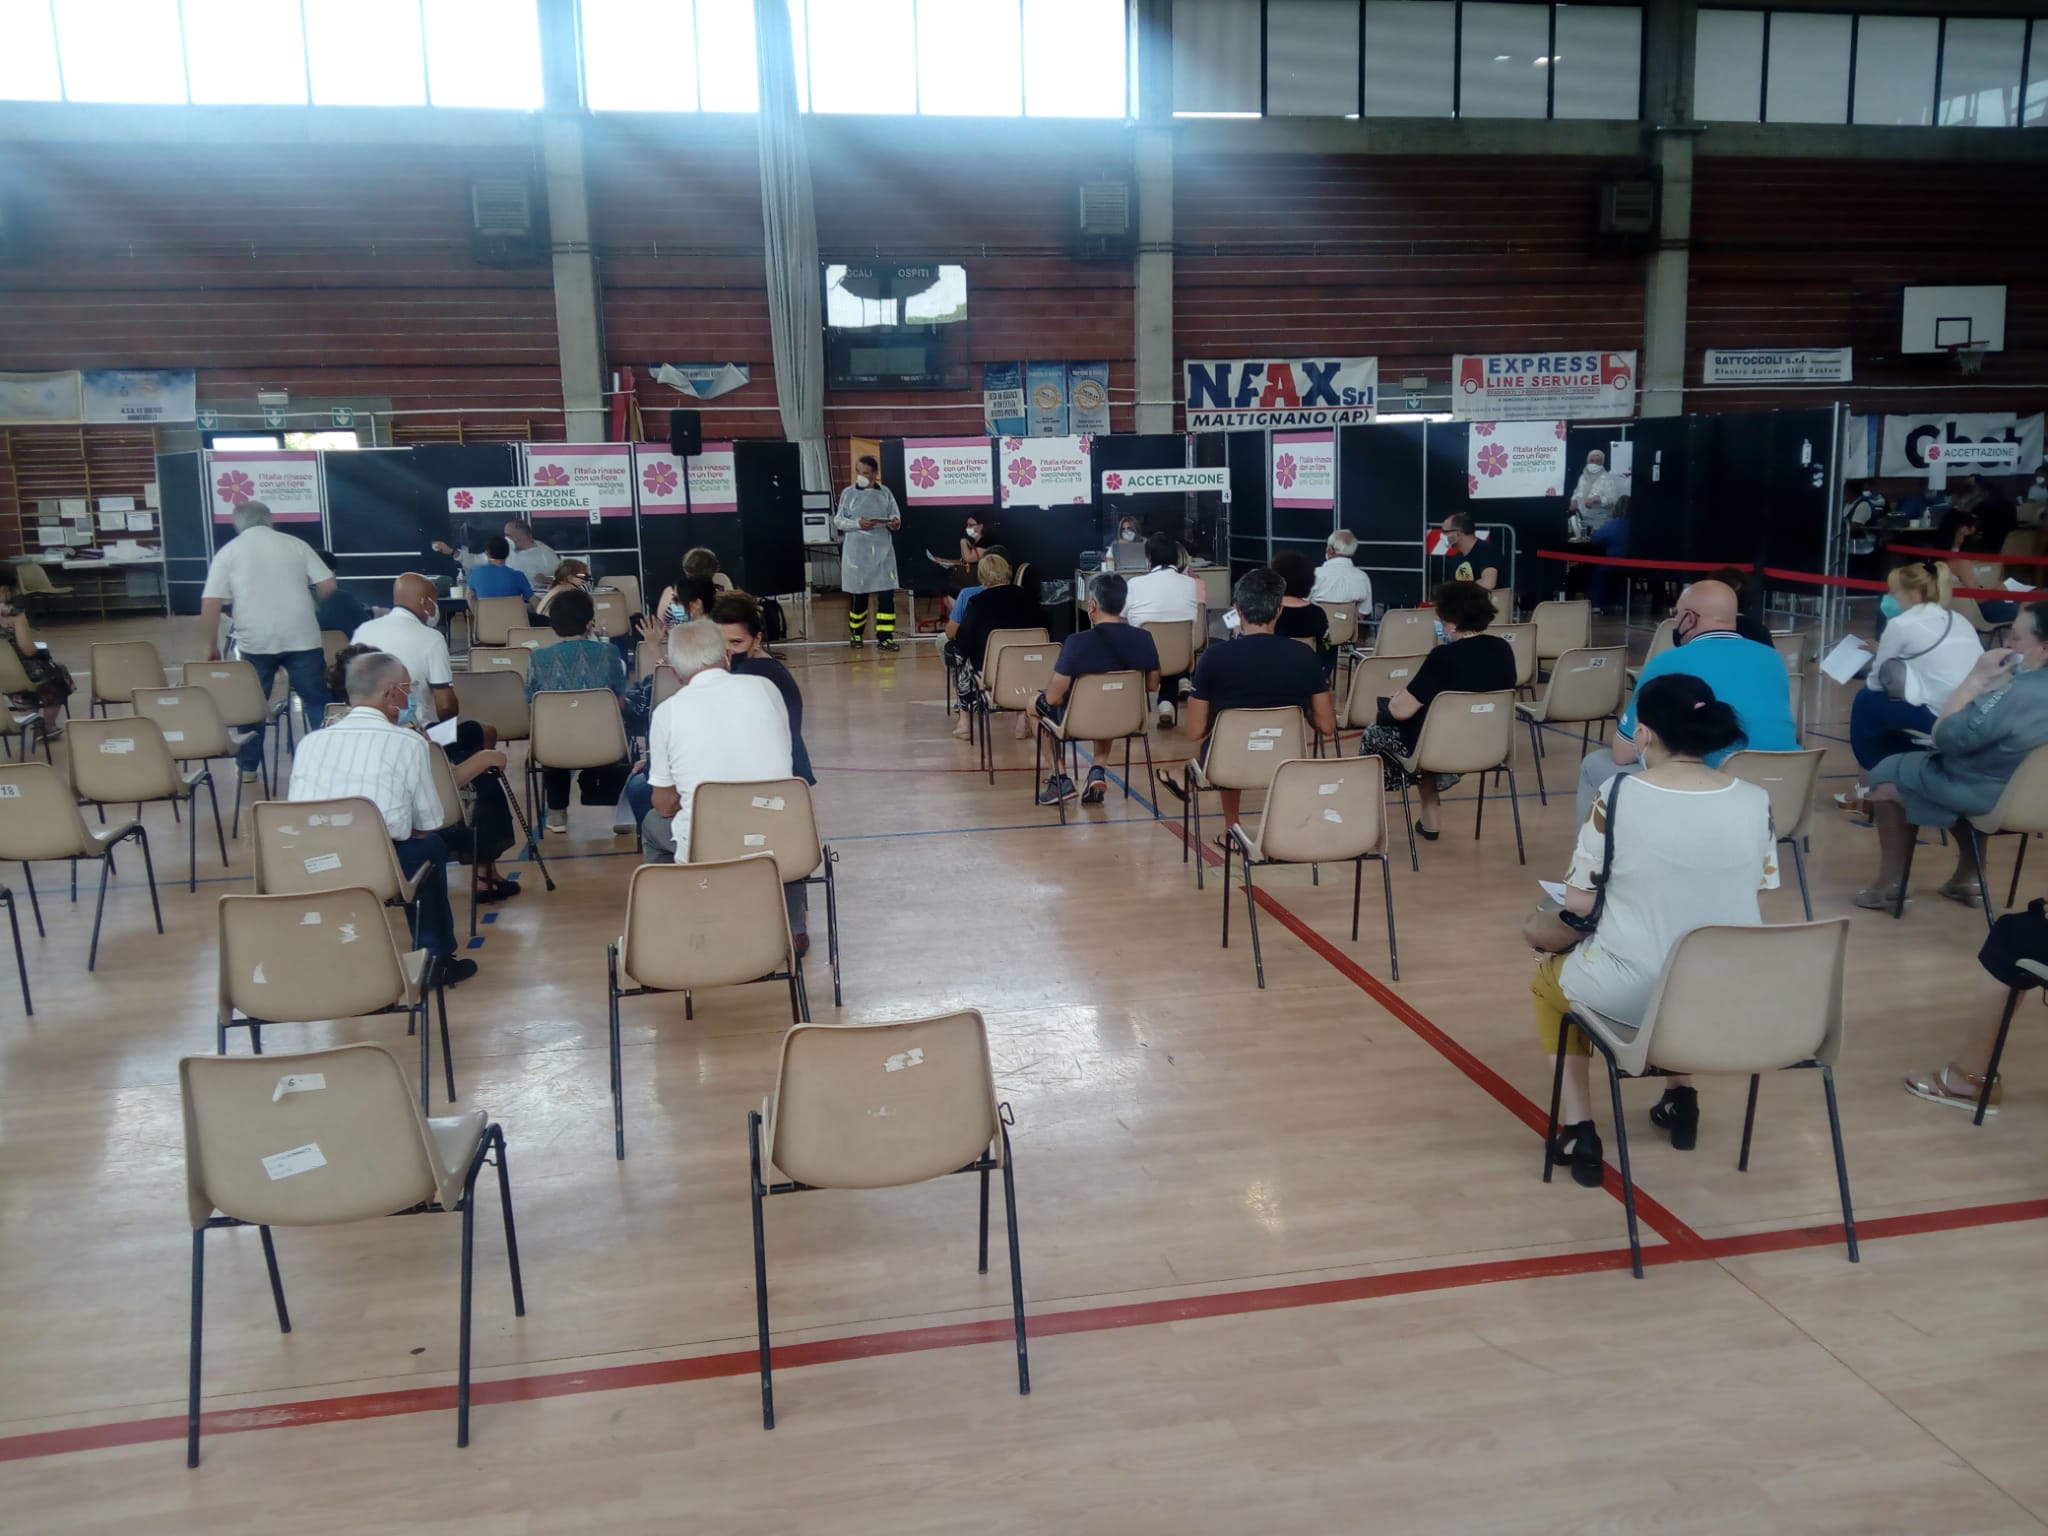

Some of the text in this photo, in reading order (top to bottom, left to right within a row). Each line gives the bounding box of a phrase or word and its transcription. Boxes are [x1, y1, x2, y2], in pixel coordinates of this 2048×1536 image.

[846, 268, 873, 278] OCALI
[898, 268, 929, 278] OSPITI
[1488, 356, 1598, 374] EXPRESS
[1714, 355, 1783, 366] BATTOCCOLI
[1187, 362, 1375, 409] NFAX Srl
[1486, 374, 1600, 388] LINE SERVICE
[1192, 409, 1370, 427] MALTIGNANO (AP)
[1534, 445, 1558, 453] rinasce
[1943, 447, 2016, 458] ACCETTAZIONE
[1536, 452, 1551, 460] fiore
[598, 467, 625, 475] rinasce
[704, 463, 731, 471] rinasce
[1062, 464, 1077, 472] fiore
[600, 474, 618, 482] fiore
[1127, 473, 1225, 487] ACCETTAZIONE
[259, 480, 274, 488] con
[492, 488, 577, 499] ACCETTAZIONE
[1223, 492, 1231, 500] 4
[479, 497, 590, 509] SEZIONE OSPEDALE
[592, 512, 599, 521] 5
